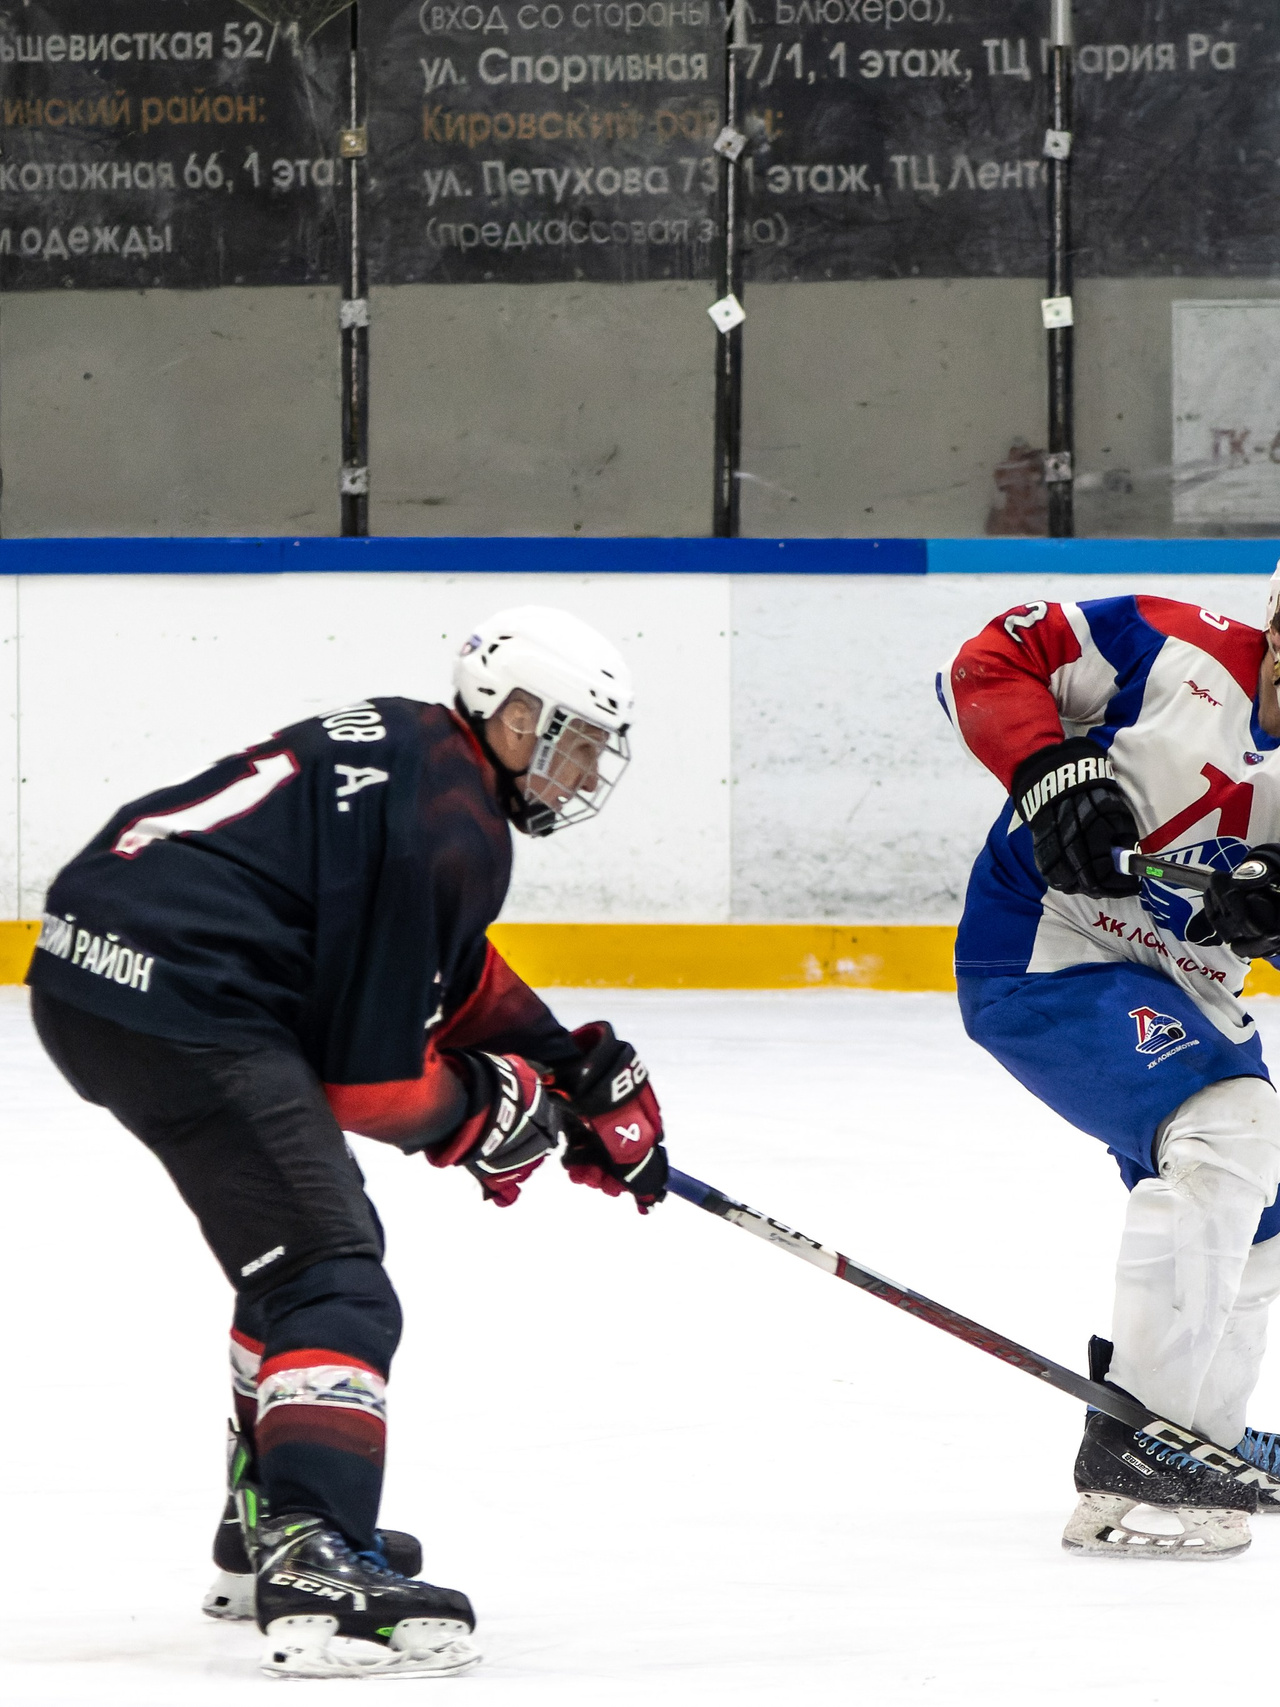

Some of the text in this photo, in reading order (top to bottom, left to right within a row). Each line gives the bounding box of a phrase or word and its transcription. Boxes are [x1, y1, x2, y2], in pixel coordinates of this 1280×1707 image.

[419, 2, 509, 36] (вход
[517, 2, 564, 29] со
[223, 21, 301, 64] 52/1
[420, 57, 468, 94] ул.
[478, 47, 709, 92] Спортивная
[828, 41, 847, 79] 1
[858, 48, 974, 83] этаж,
[982, 37, 1032, 82] ТЦ
[1041, 37, 1176, 81] ария
[1186, 33, 1238, 71] Ра
[142, 88, 268, 133] район:
[183, 151, 234, 193] 66,
[243, 150, 261, 188] 1
[271, 157, 343, 189] эта
[423, 168, 472, 206] ул.
[482, 160, 670, 202] Петухова
[766, 163, 883, 199] этаж,
[890, 154, 942, 197] ТЦ
[20, 225, 173, 261] одежды
[1092, 911, 1127, 938] ХК
[71, 928, 155, 993] РАЙОН
[268, 1572, 348, 1602] CCM
